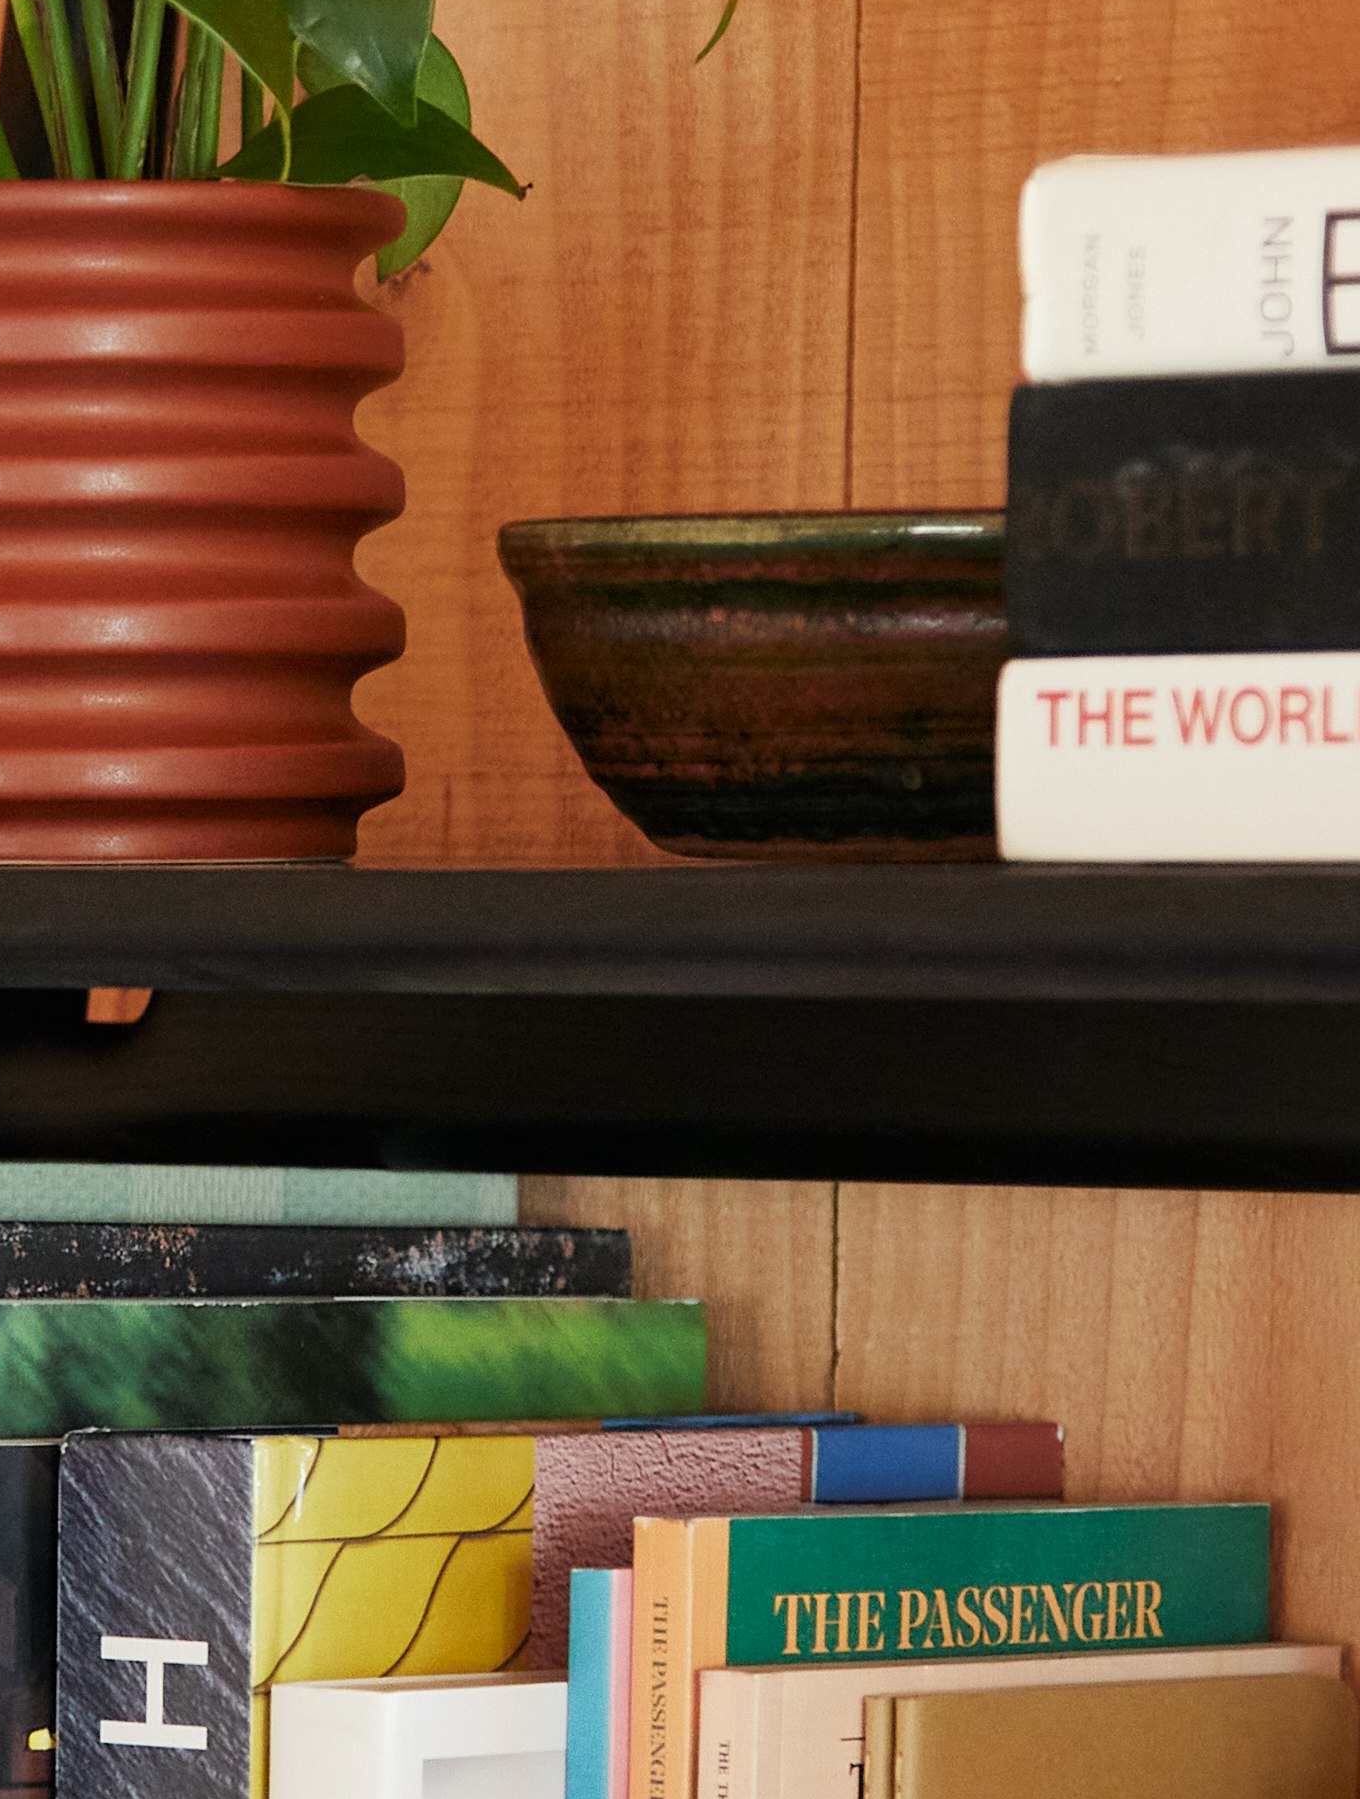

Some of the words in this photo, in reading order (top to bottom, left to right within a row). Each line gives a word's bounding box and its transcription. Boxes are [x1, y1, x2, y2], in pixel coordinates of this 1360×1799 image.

[1127, 245, 1145, 339] JONES
[1260, 215, 1295, 358] JOHN
[1037, 689, 1156, 749] THE
[654, 1597, 669, 1651] THE
[773, 1592, 886, 1656] THE
[897, 1580, 1164, 1652] PASSENGER
[718, 1740, 730, 1775] THE
